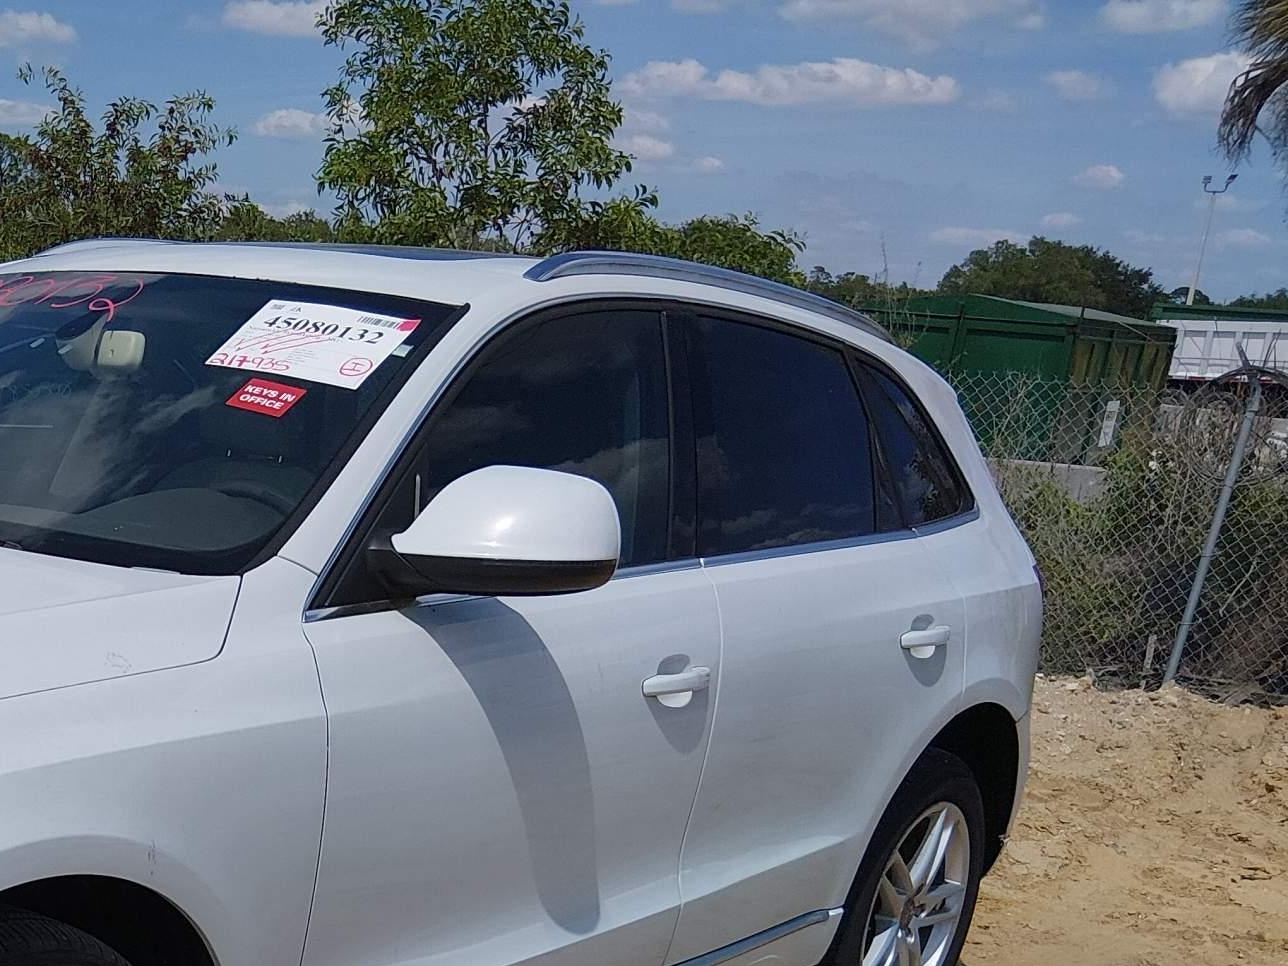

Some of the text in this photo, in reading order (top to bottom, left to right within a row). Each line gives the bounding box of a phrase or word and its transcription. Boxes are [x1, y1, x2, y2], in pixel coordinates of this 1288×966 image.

[264, 316, 384, 344] 45080132
[239, 394, 285, 410] OFFICE
[244, 385, 296, 402] KEYS IN
